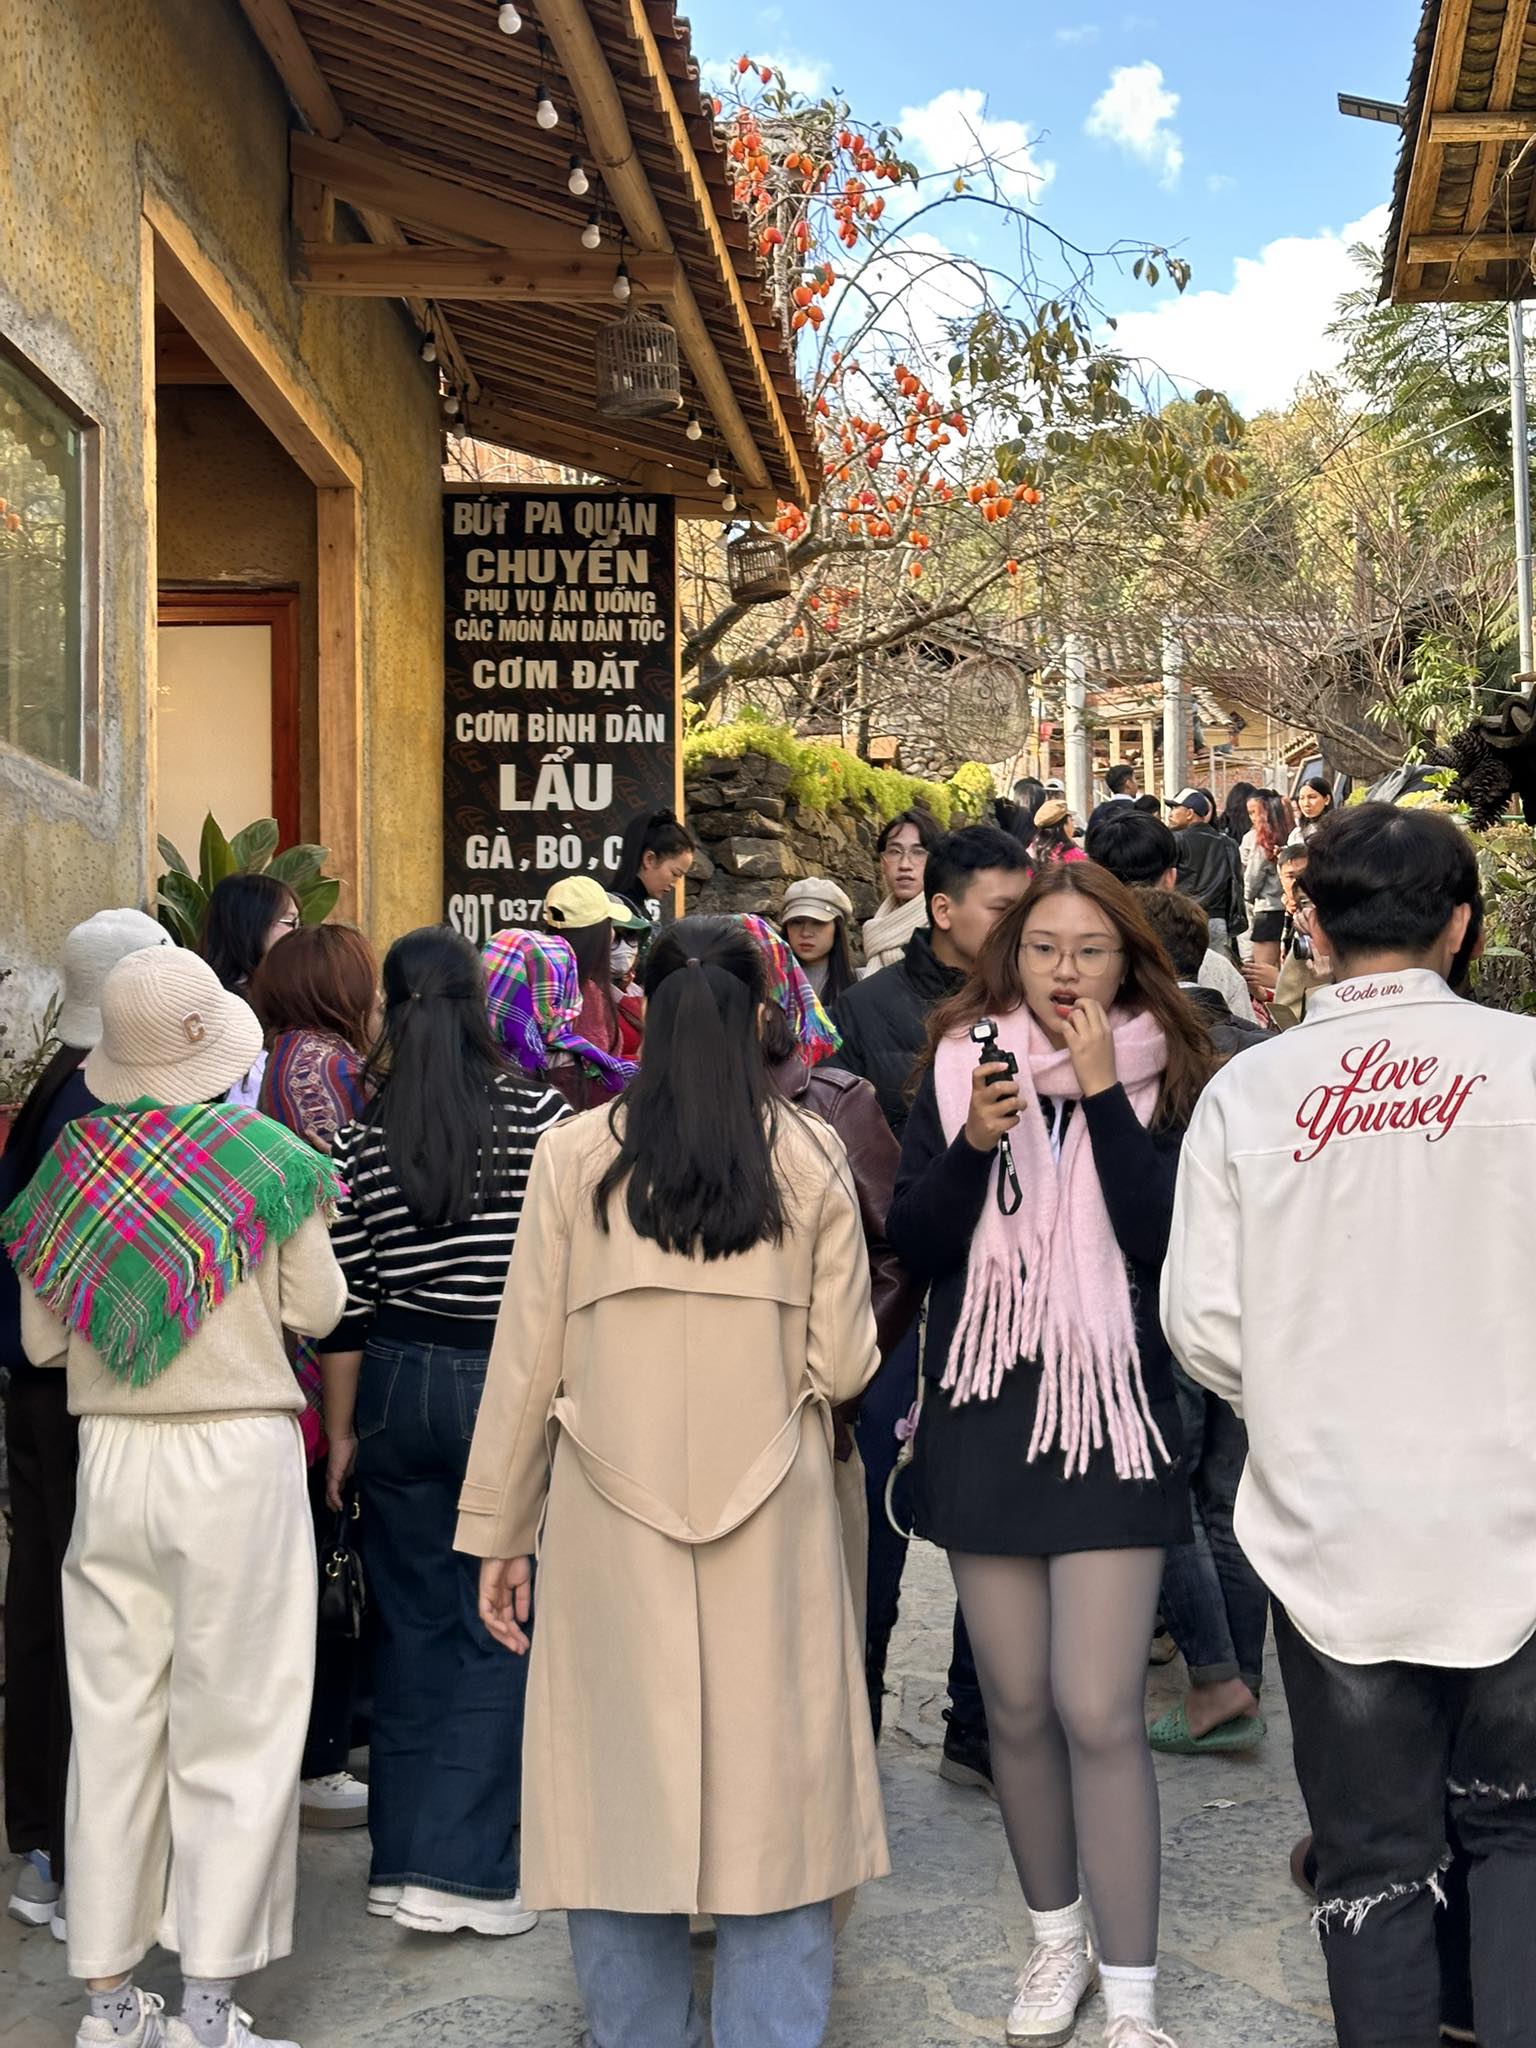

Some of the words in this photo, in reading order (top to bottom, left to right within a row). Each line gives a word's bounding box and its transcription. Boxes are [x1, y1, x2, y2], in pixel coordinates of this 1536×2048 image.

[525, 501, 564, 535] PA
[574, 497, 657, 538] QUÁN
[465, 589, 509, 616] PHỤ
[515, 589, 546, 617] VỤ
[553, 585, 587, 612] ĂN
[455, 613, 493, 641] CÁC
[499, 615, 544, 642] MÓN
[549, 614, 577, 642] ĂN
[582, 614, 623, 642] DÂN
[628, 614, 666, 645] TỘC
[472, 657, 557, 689] CƠM
[571, 652, 640, 696] ĐẶT
[456, 710, 519, 743] CƠM
[528, 706, 596, 743] BÌNH
[605, 704, 665, 743] DÂN
[499, 745, 613, 811] LẨU
[448, 893, 495, 945] SĐT
[1335, 983, 1379, 1003] Code
[1332, 1038, 1439, 1095] Love
[1293, 1074, 1487, 1163] Yourself
